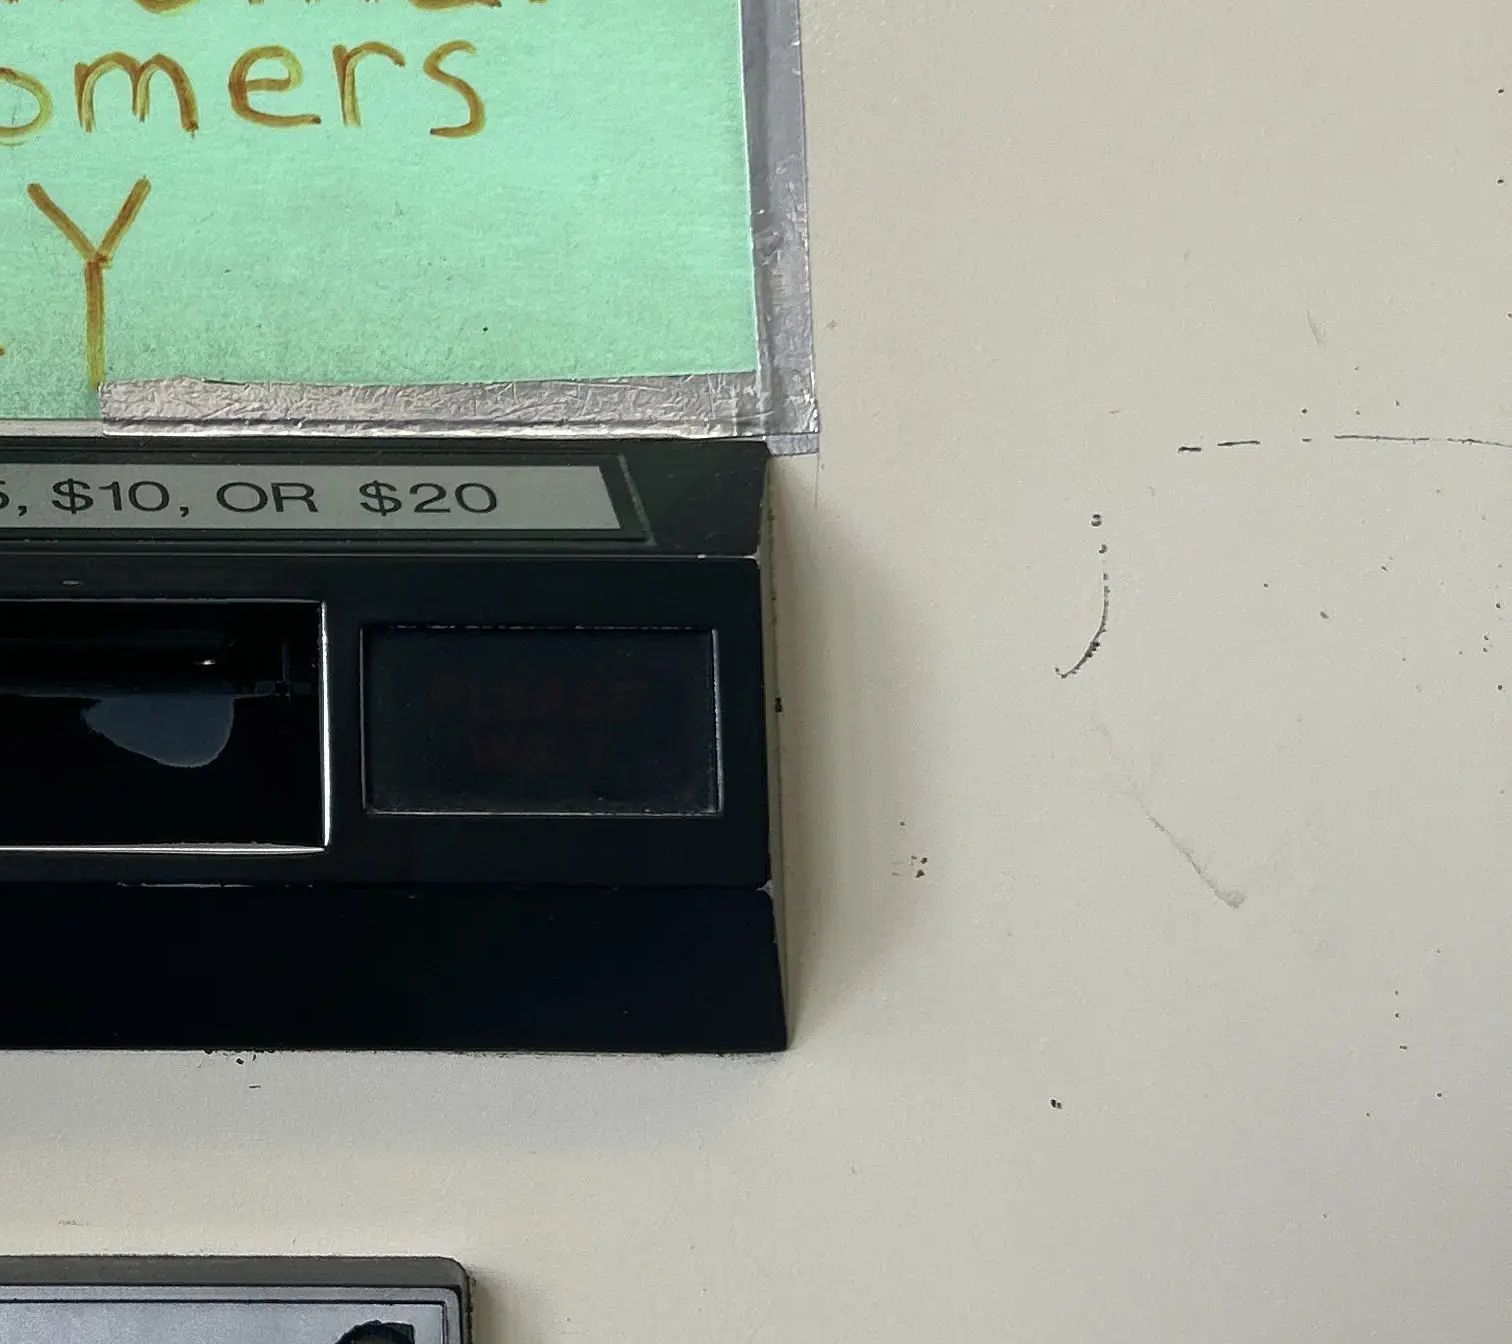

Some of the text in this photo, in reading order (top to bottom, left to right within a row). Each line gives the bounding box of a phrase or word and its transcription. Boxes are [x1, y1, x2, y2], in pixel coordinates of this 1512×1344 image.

[51, 477, 191, 518] $10,
[216, 480, 320, 514] OR
[358, 479, 499, 518] $20
